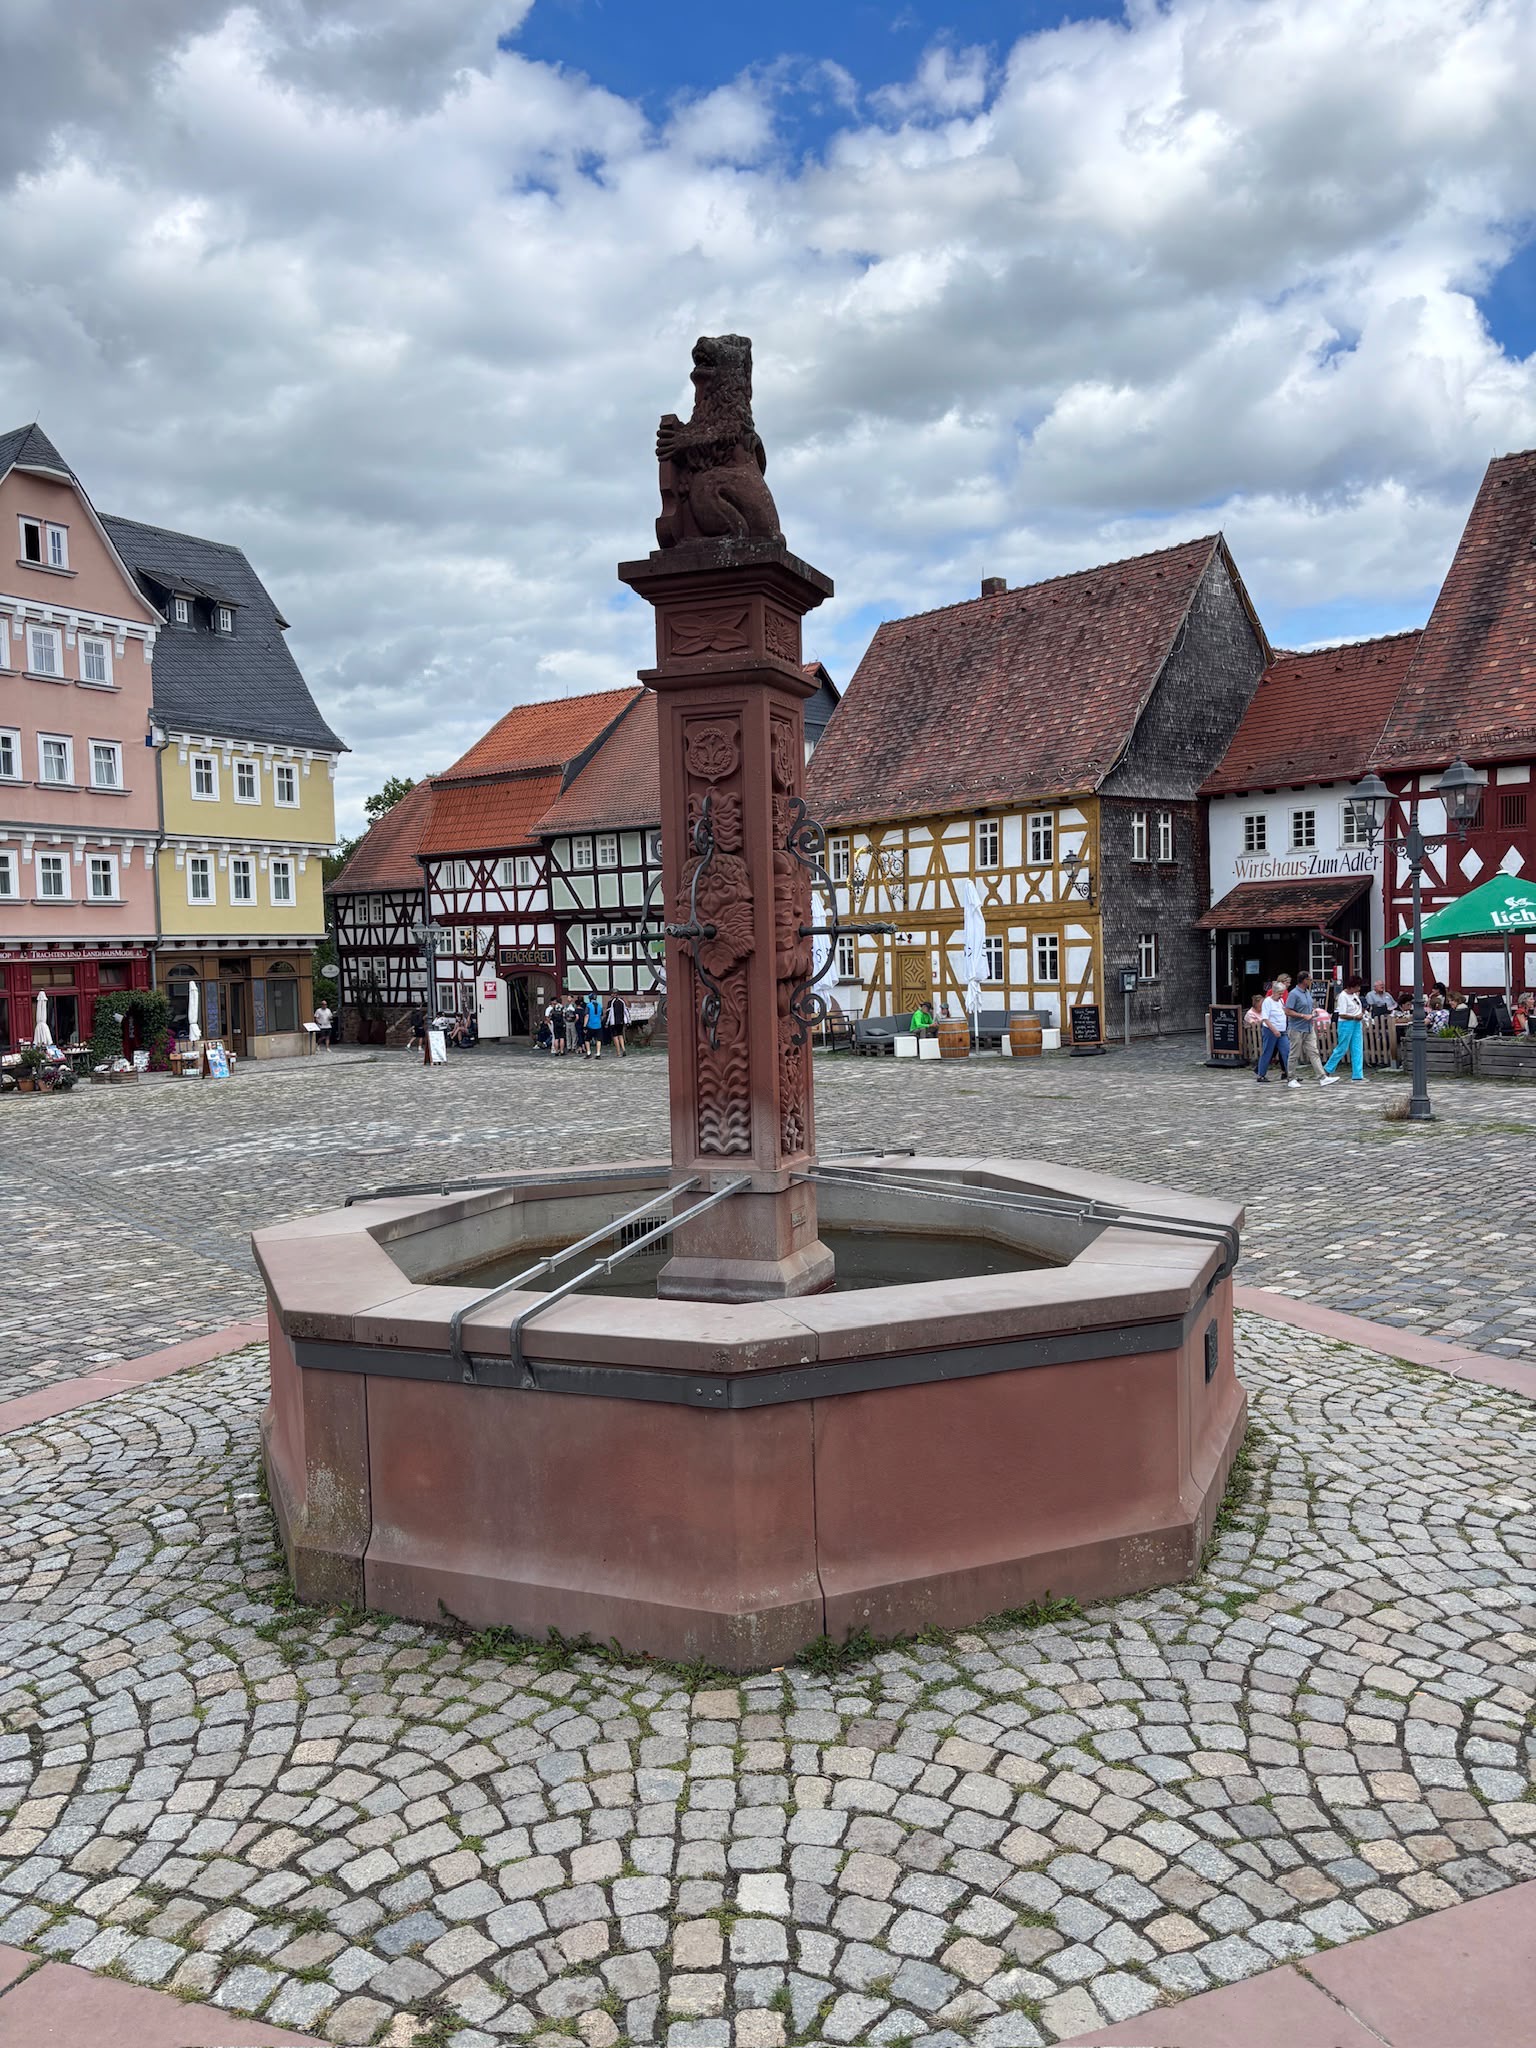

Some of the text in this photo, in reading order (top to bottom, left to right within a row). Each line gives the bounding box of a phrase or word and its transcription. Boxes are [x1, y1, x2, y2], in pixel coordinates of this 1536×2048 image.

[1235, 851, 1379, 878] Wirtshaus Zum Adler
